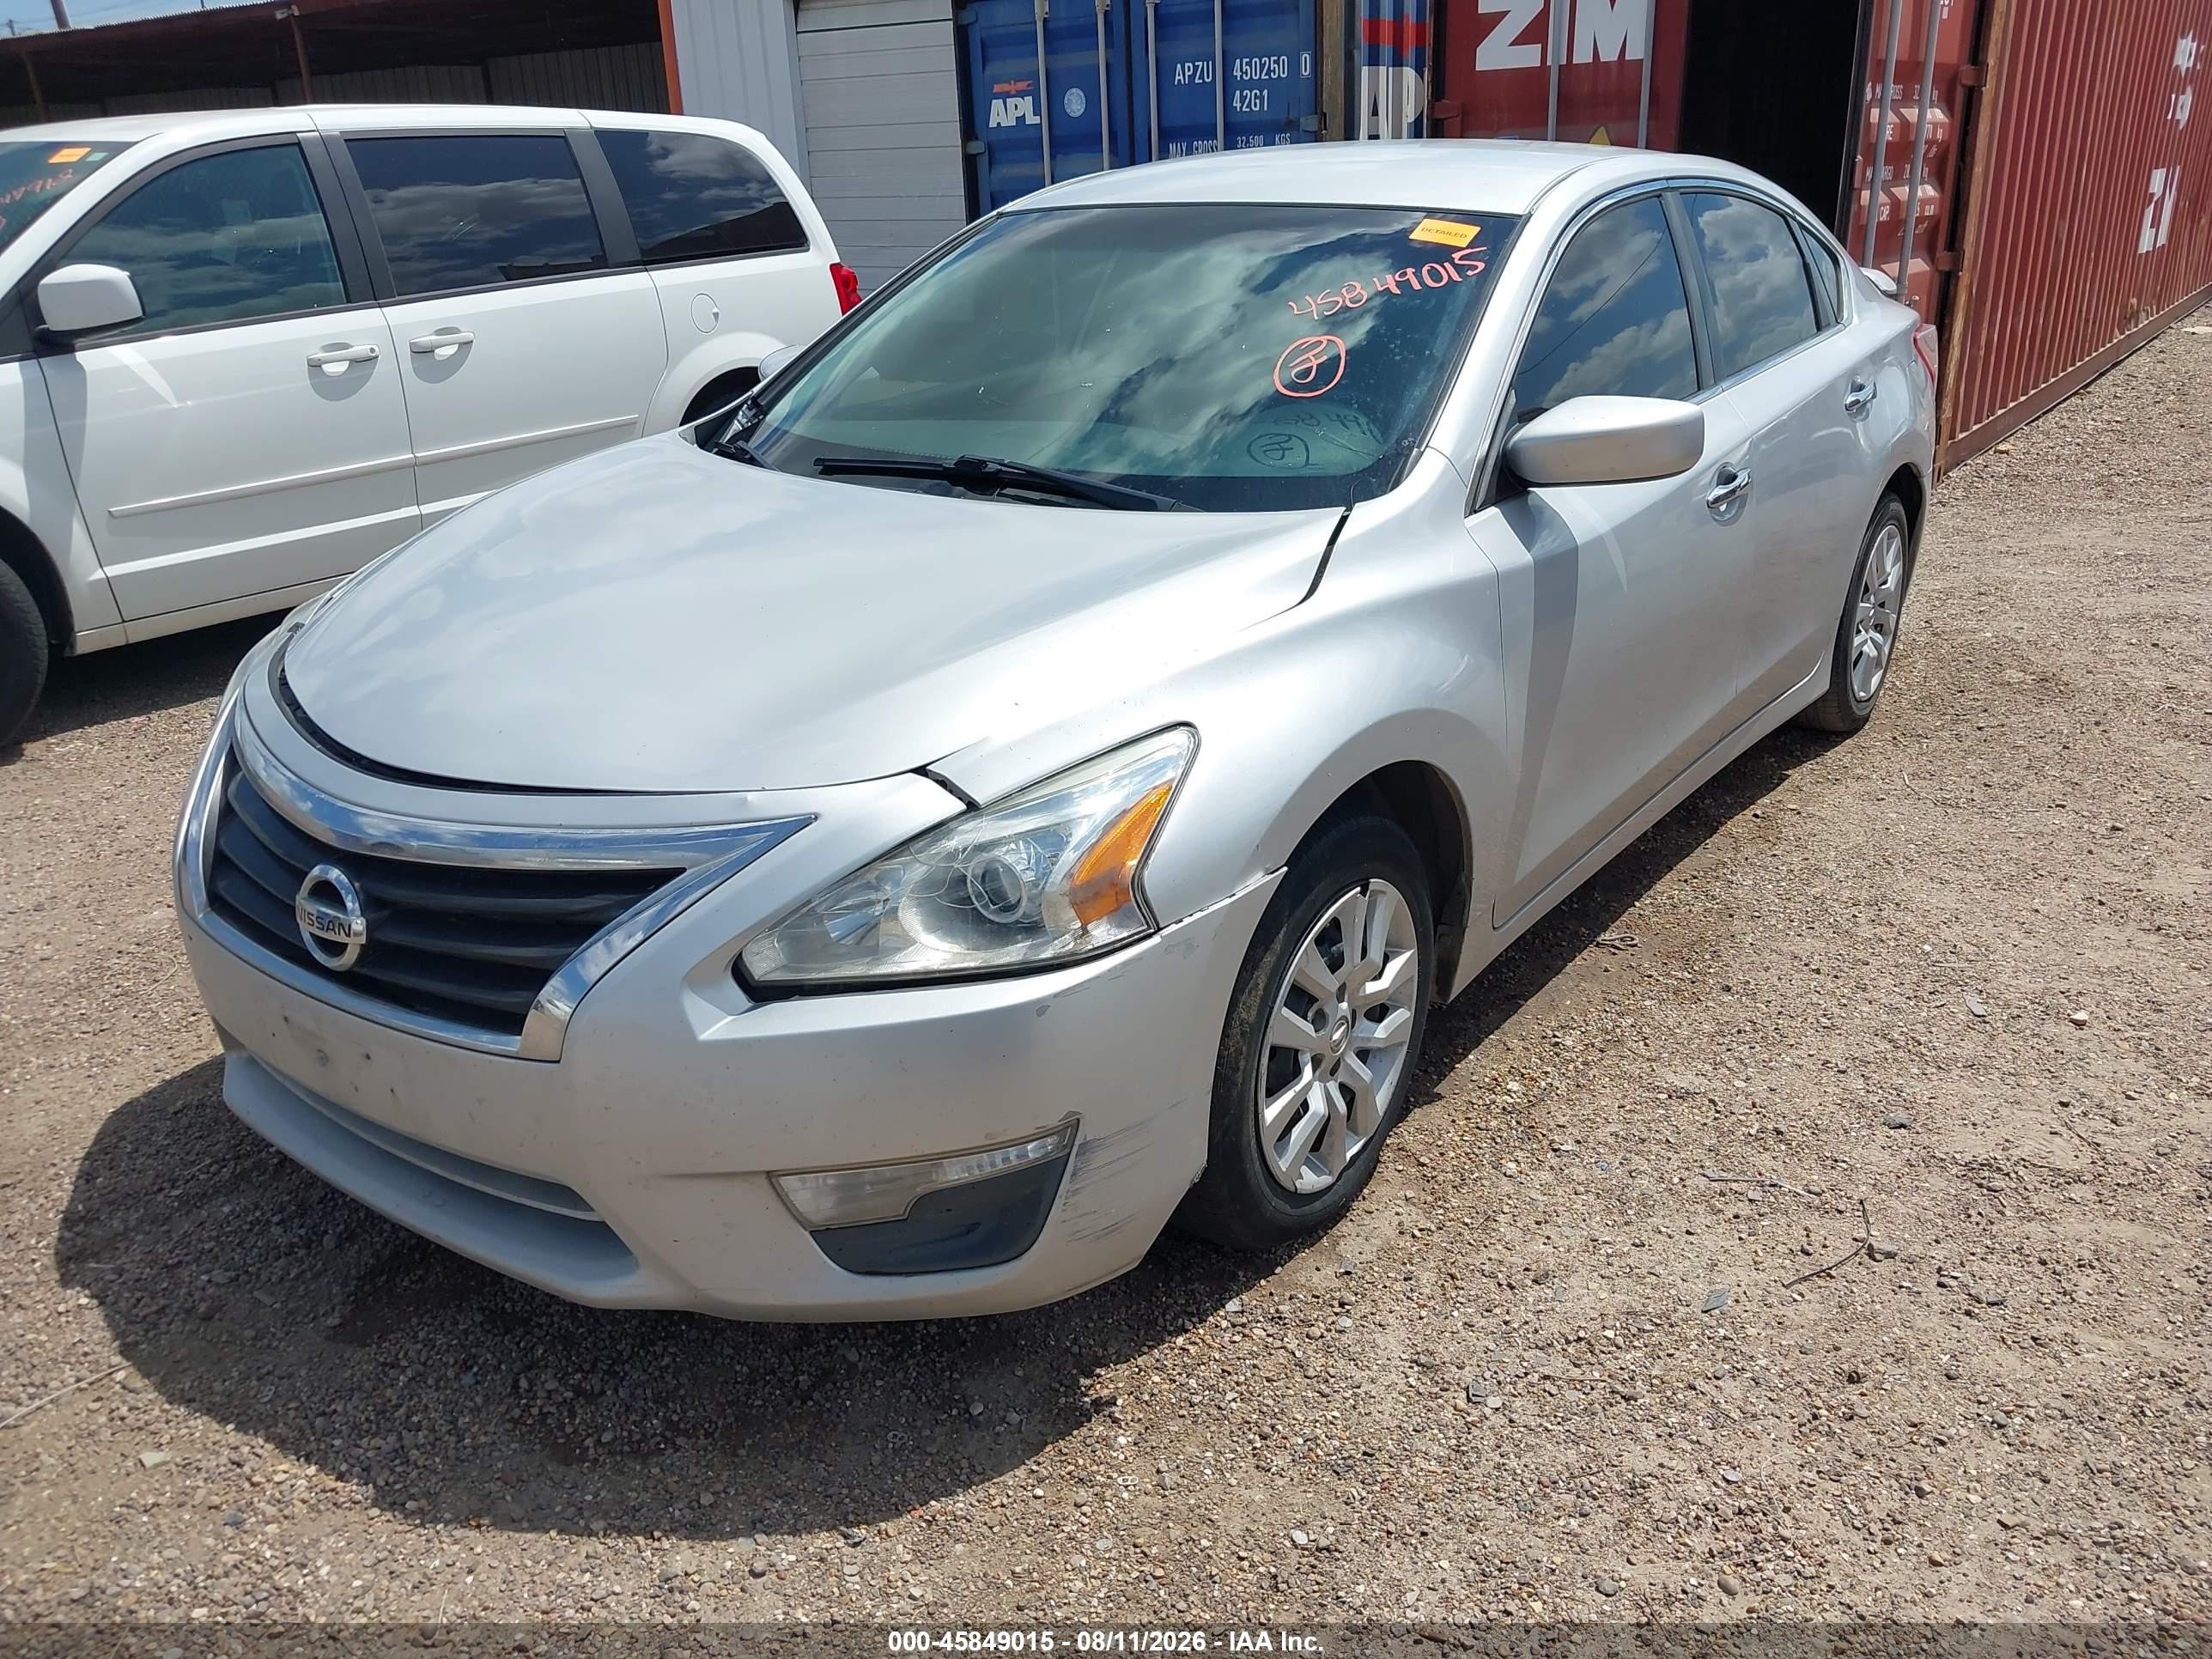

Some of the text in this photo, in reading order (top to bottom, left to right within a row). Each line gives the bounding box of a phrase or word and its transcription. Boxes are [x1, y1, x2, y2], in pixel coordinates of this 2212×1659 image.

[1476, 0, 1646, 71] ZIM
[1174, 53, 1310, 85] APZU 450250 0
[988, 95, 1041, 128] APL
[1233, 88, 1268, 112] 42G1
[1359, 66, 1427, 140] AP
[1169, 142, 1188, 158] MAX
[1193, 139, 1218, 155] GROSS
[1275, 133, 1291, 145] KGS
[1421, 227, 1468, 239] DETAILED
[296, 906, 352, 938] NISSAN
